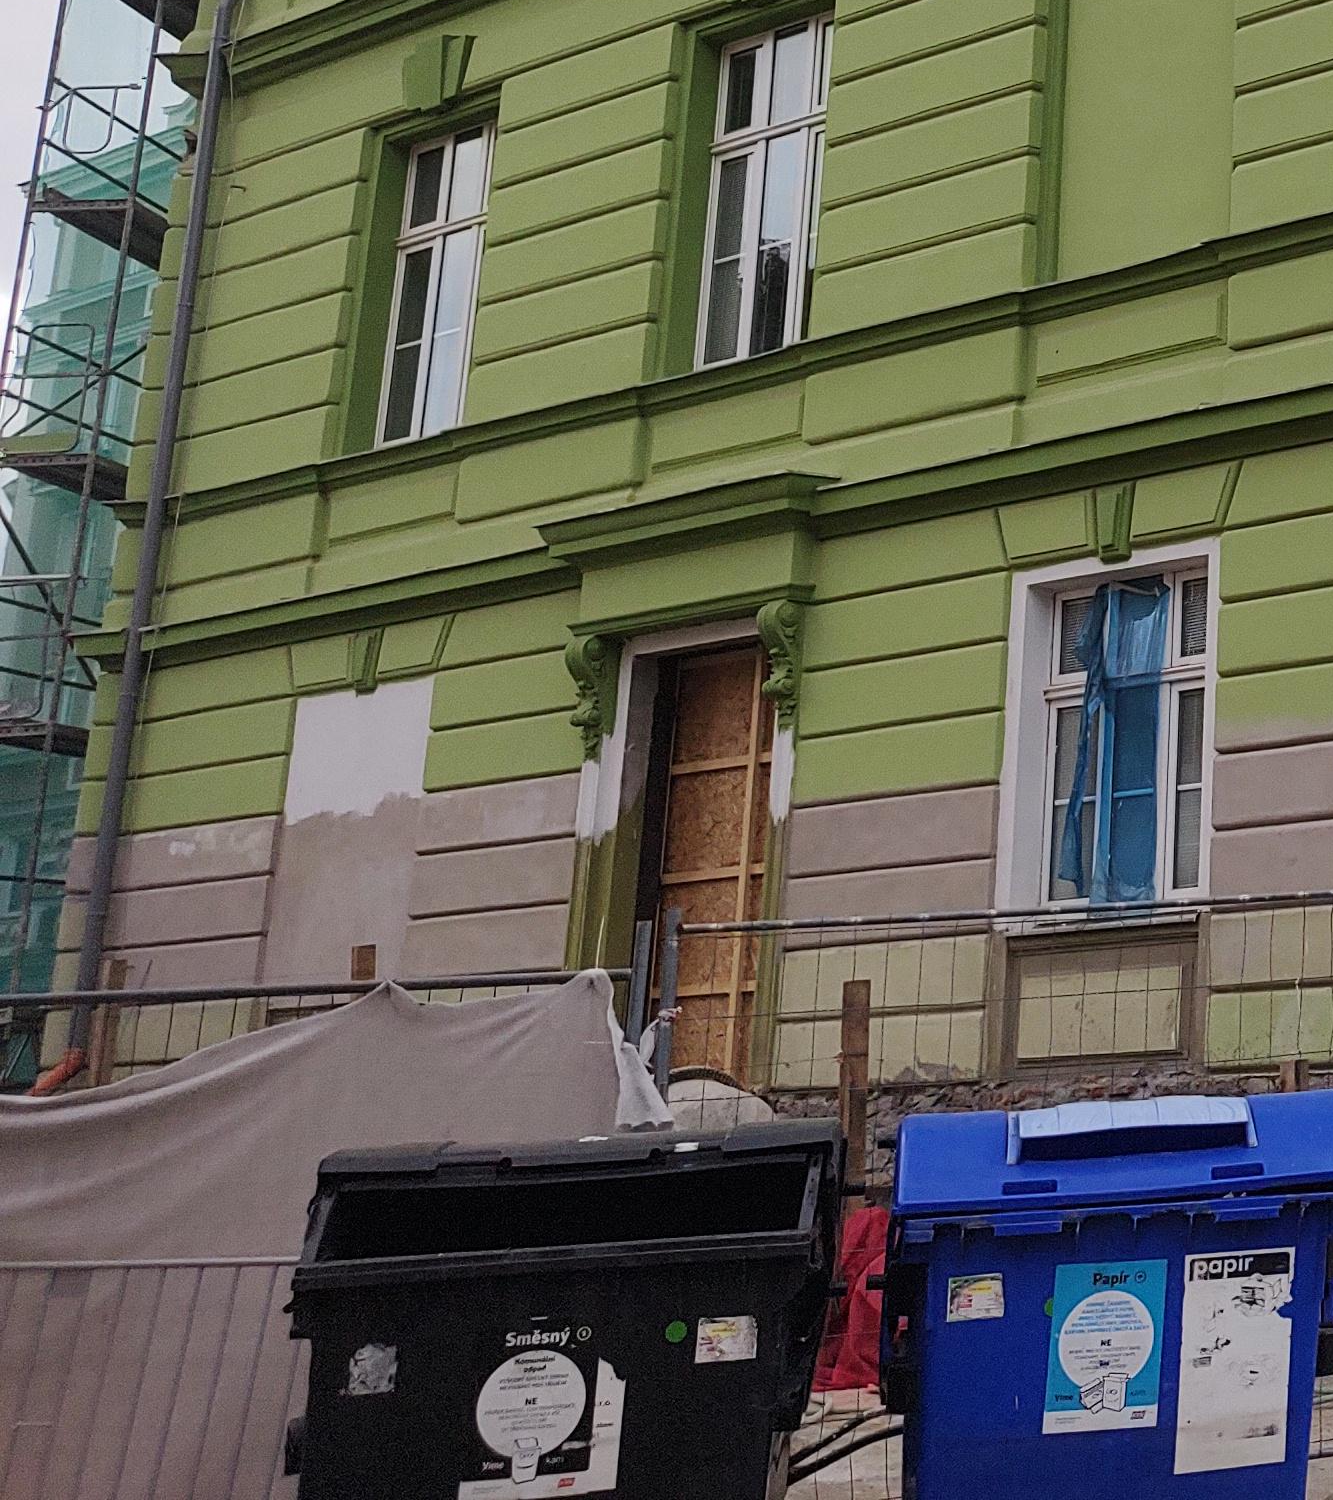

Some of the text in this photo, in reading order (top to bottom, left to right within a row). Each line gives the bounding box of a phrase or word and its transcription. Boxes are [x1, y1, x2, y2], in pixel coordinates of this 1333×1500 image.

[1092, 1271, 1130, 1288] Papír
[505, 1326, 571, 1347] Směsný
[524, 1397, 538, 1406] NE
